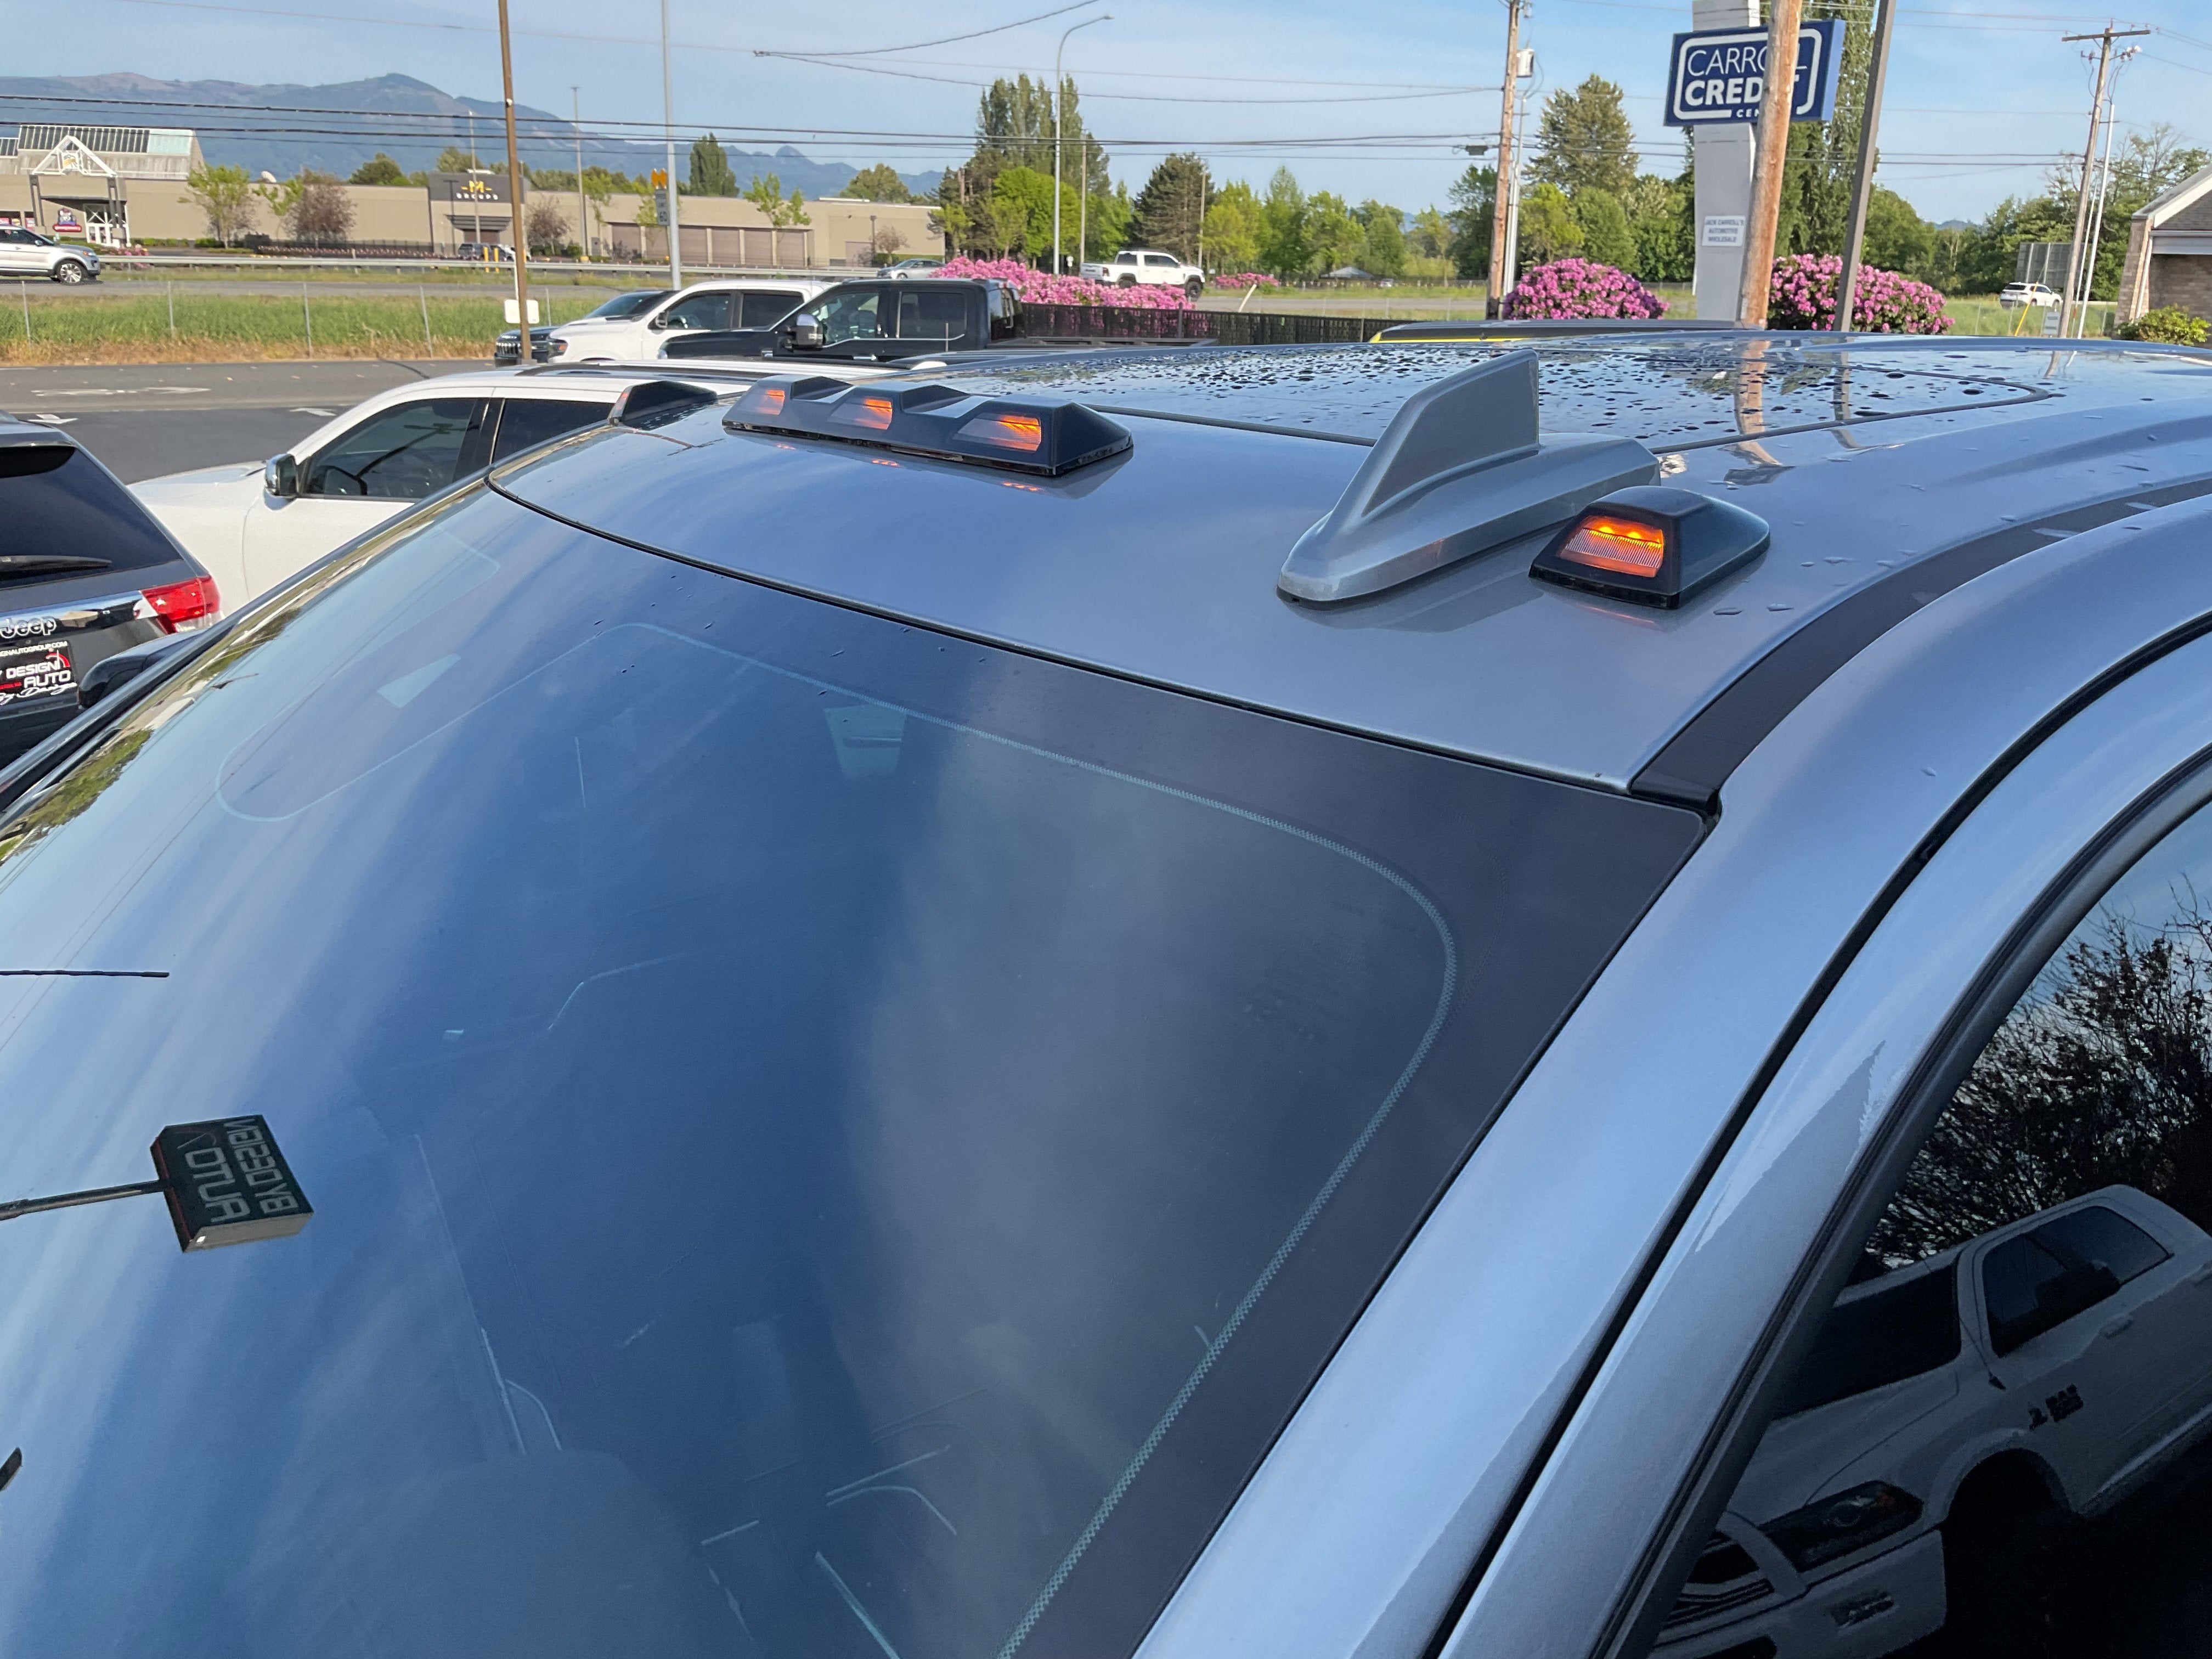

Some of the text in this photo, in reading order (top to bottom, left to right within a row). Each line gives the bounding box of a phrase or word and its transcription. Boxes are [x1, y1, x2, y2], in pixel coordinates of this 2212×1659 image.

[1687, 43, 1807, 76] CARRL
[1685, 74, 1799, 106] CRED
[0, 616, 57, 639] Jeep
[0, 641, 67, 657] GNAUTOGROUP.COM
[6, 660, 58, 679] DESIGN
[24, 670, 71, 689] AUTO
